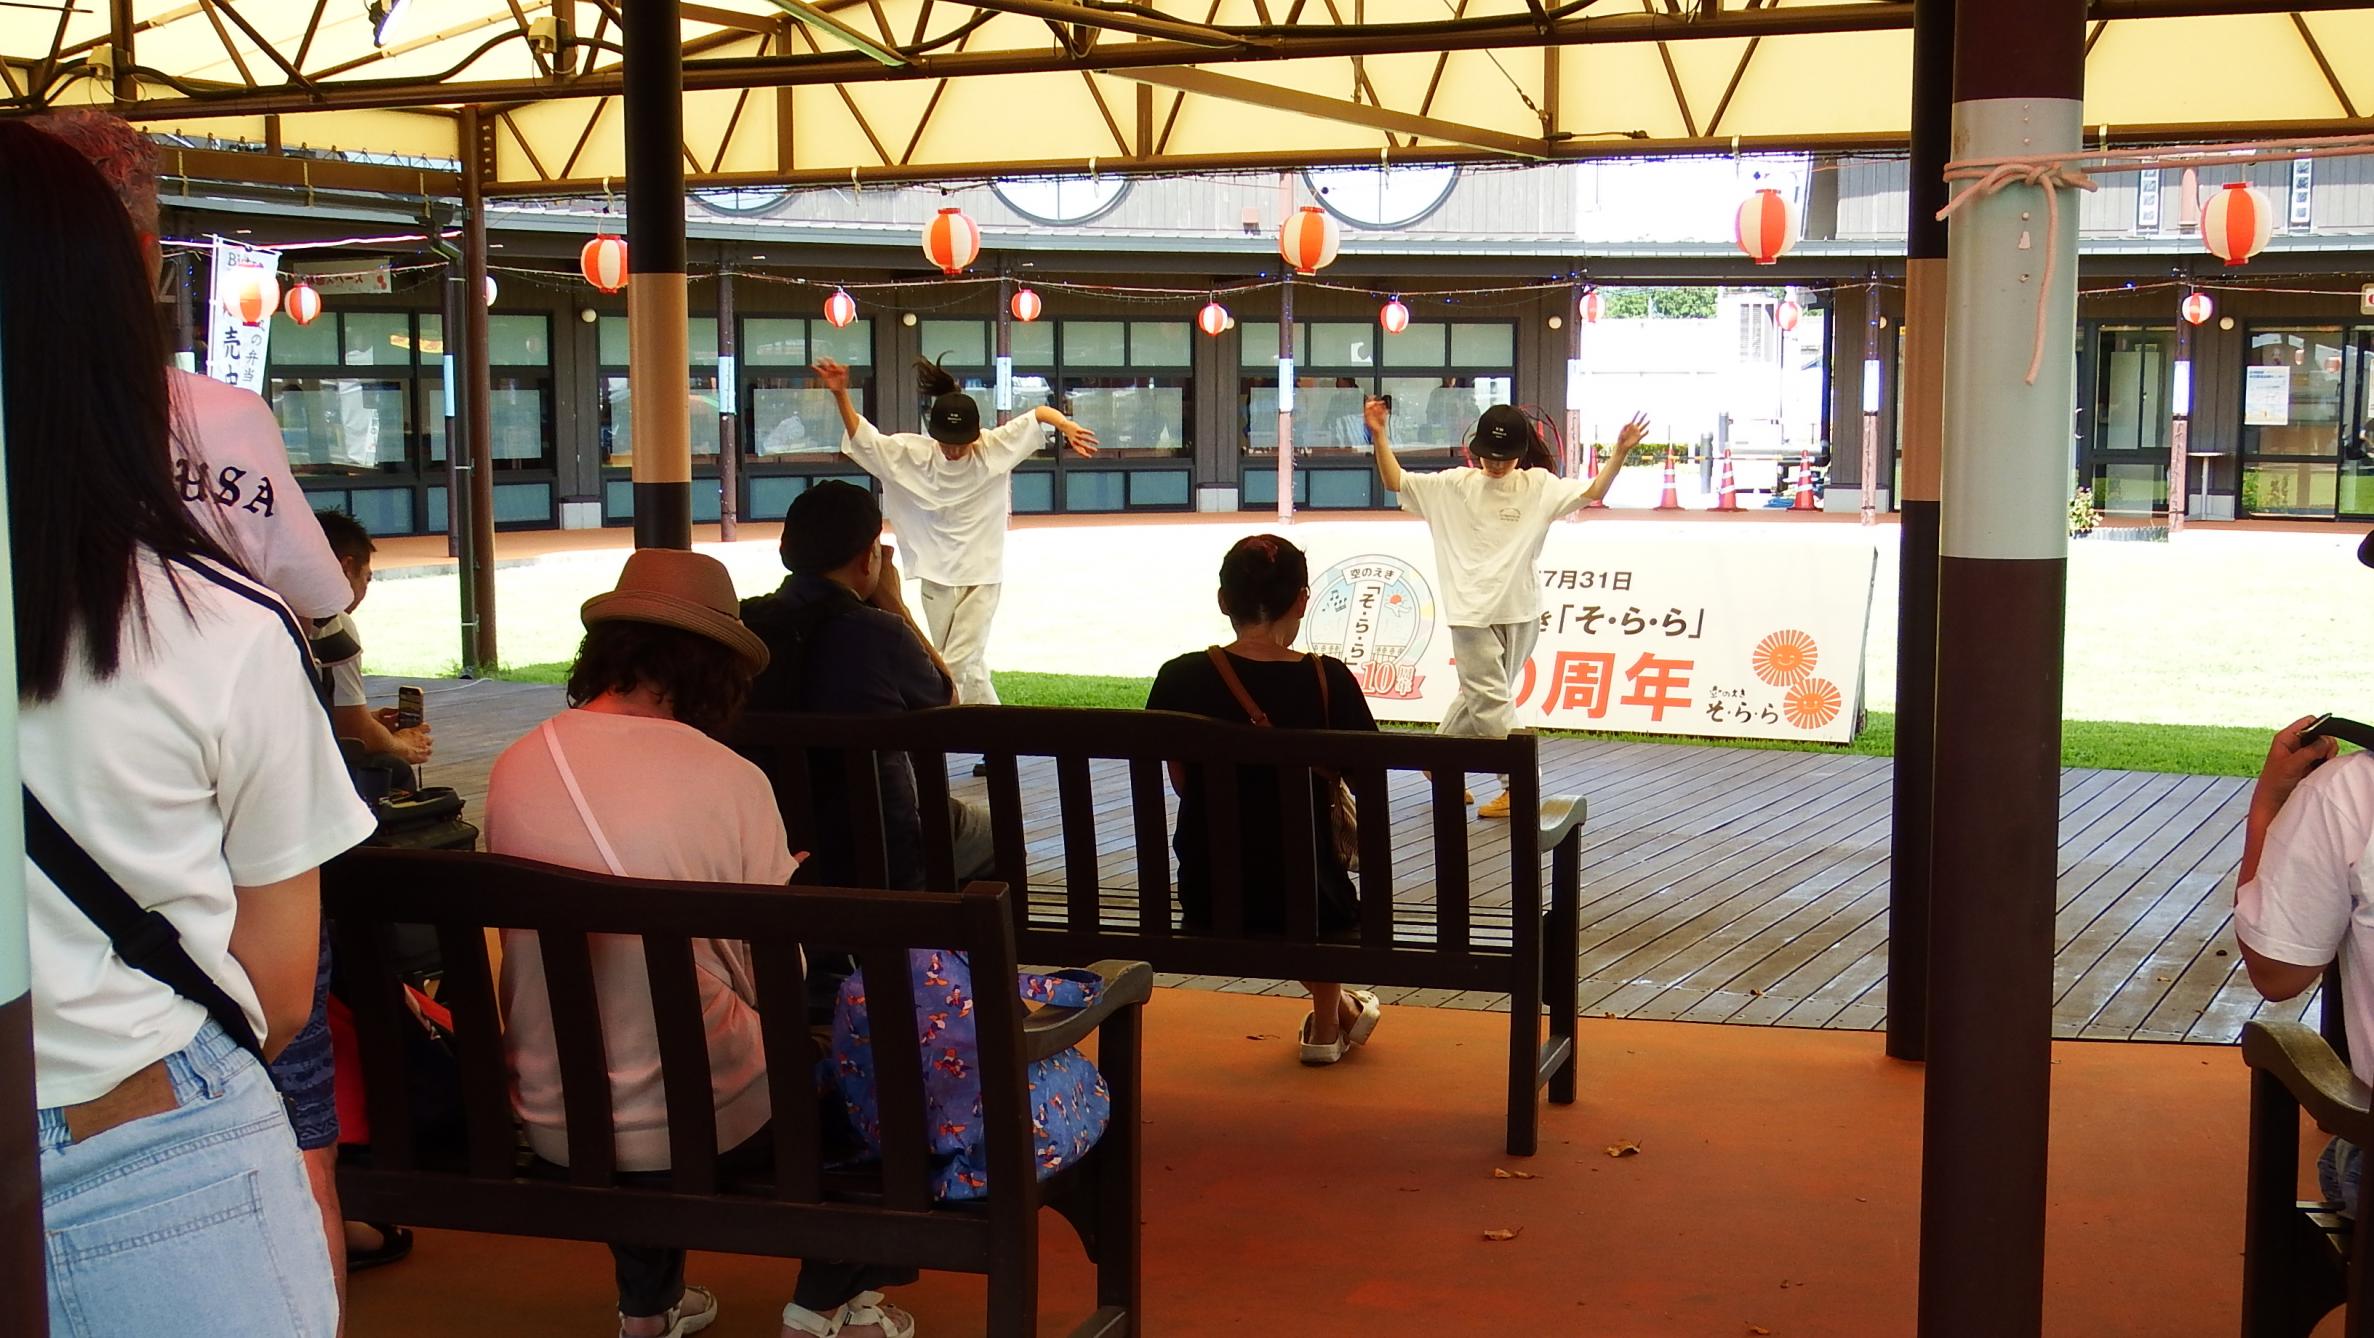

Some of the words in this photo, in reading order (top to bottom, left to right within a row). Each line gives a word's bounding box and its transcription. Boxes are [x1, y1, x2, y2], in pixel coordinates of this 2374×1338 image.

[243, 320, 266, 383] の弁当
[175, 458, 274, 518] USA
[1350, 567, 1395, 580] 空のえき
[1539, 570, 1632, 591] 7月31日
[1449, 651, 1695, 722] 周年
